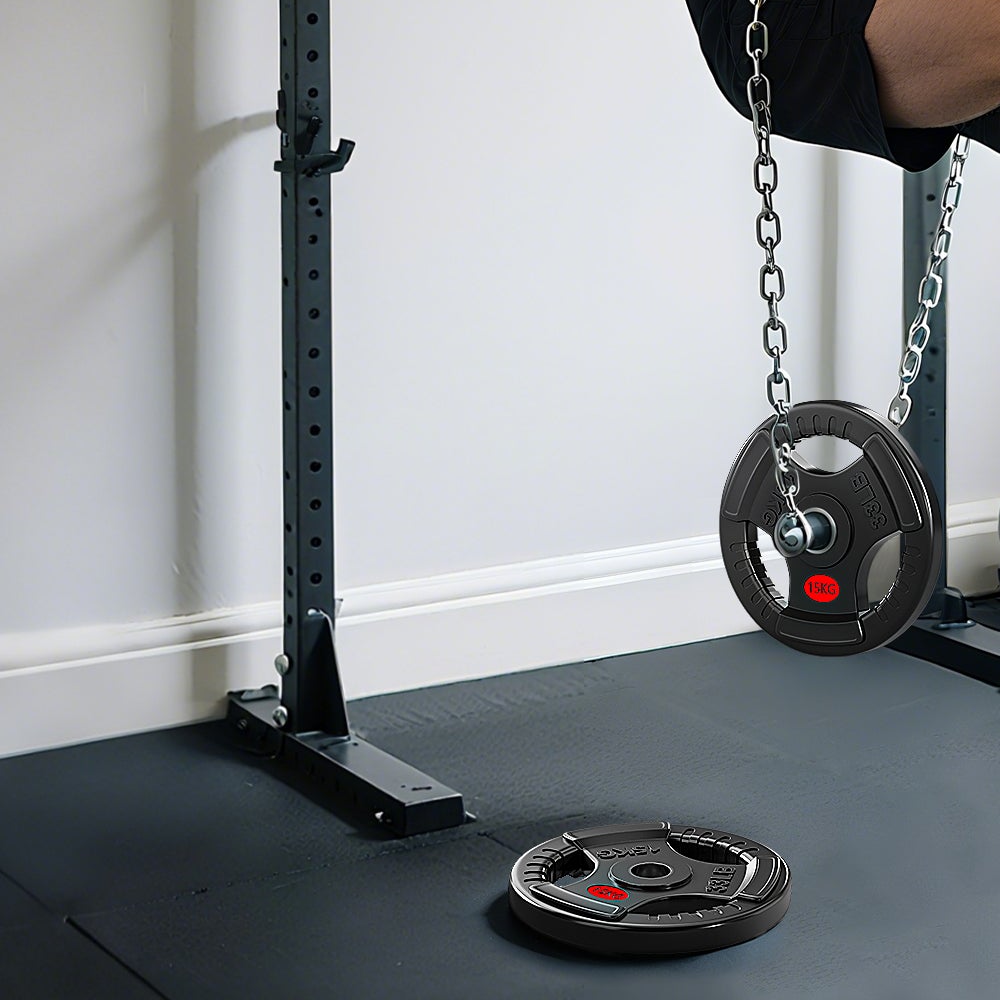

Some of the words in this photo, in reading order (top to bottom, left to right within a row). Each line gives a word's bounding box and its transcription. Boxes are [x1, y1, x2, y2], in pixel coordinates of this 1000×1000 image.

[852, 471, 888, 530] 33LB
[808, 582, 837, 596] 15KG
[704, 866, 737, 893] 33LB
